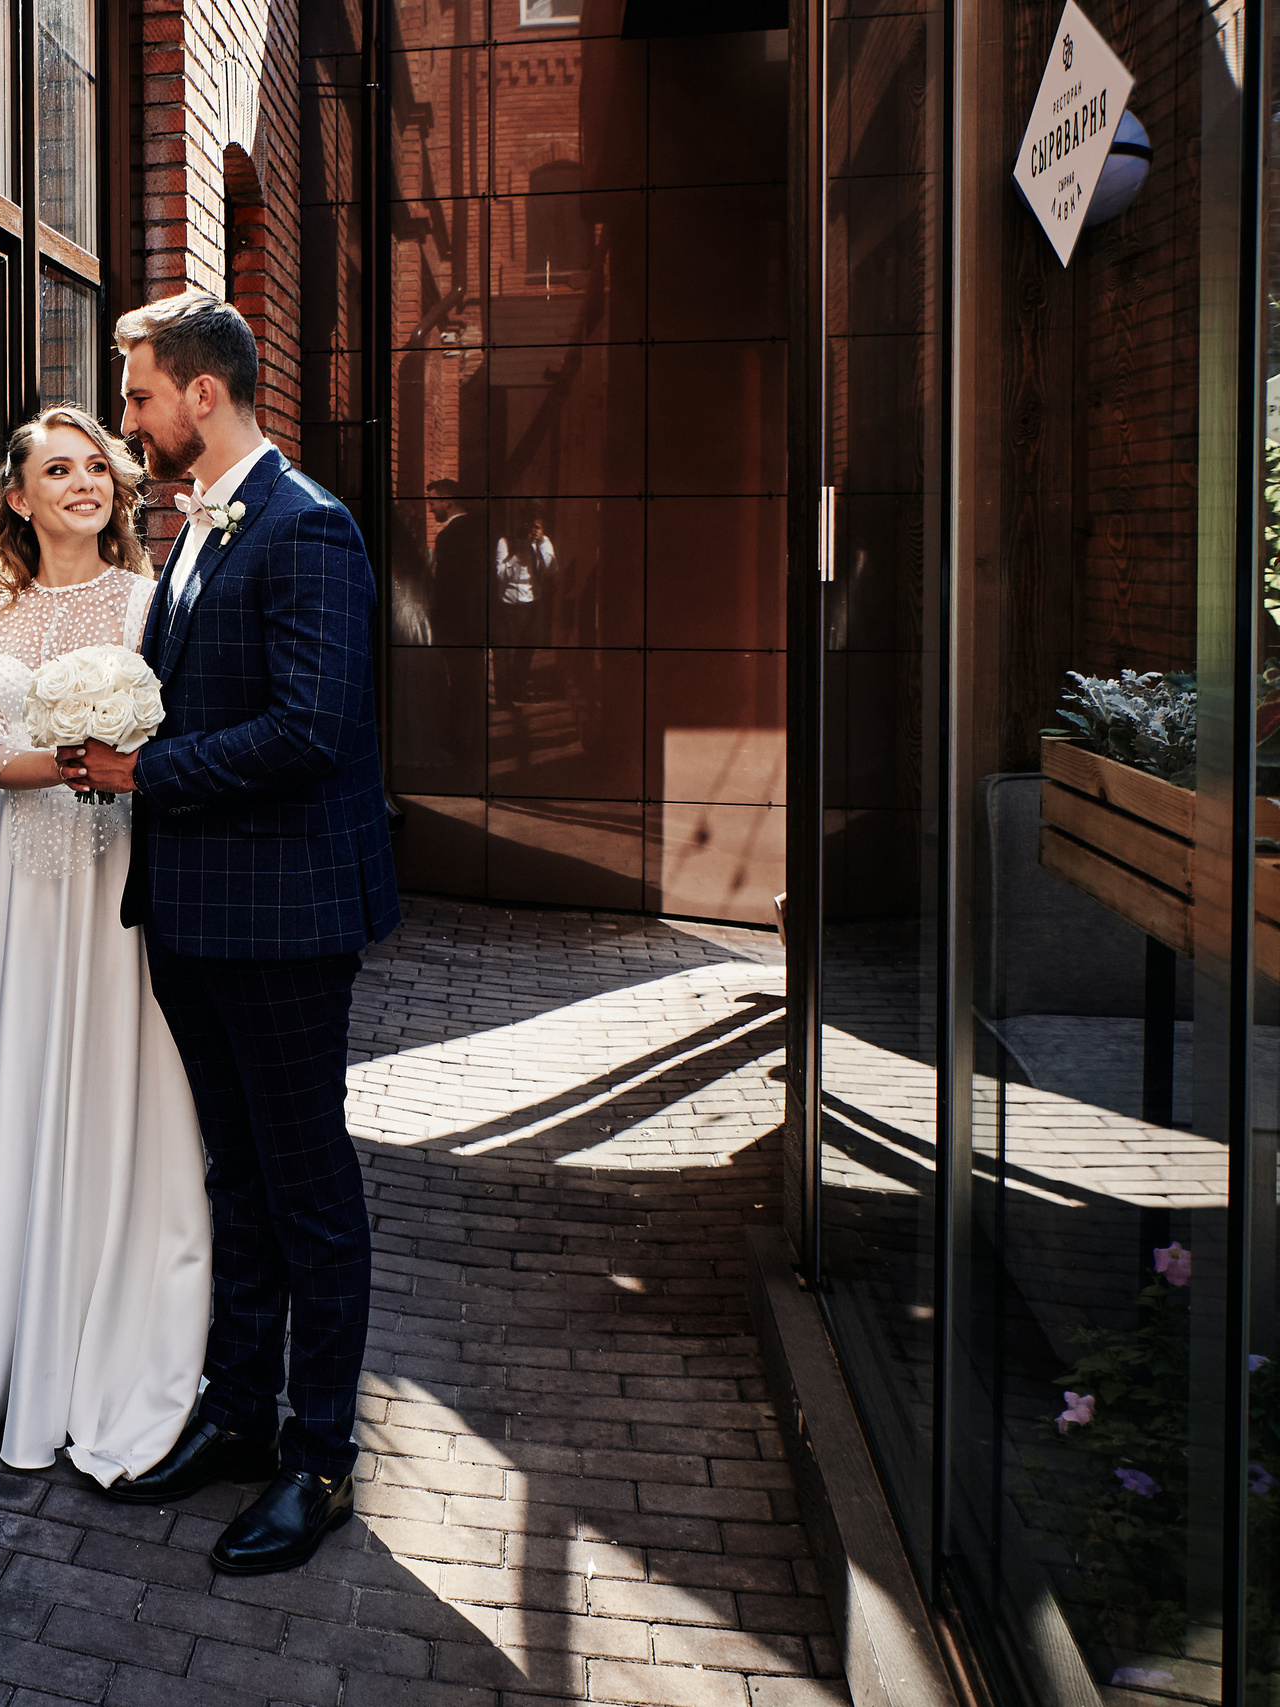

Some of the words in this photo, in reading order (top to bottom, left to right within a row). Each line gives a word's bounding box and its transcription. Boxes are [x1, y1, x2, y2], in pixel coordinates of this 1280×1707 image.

[1053, 80, 1082, 116] РЕСТОРАН
[1031, 88, 1107, 178] СЫРОВАРНЯ
[1058, 171, 1075, 193] СЫРНАЯ
[1051, 183, 1082, 221] ЛАВКА
